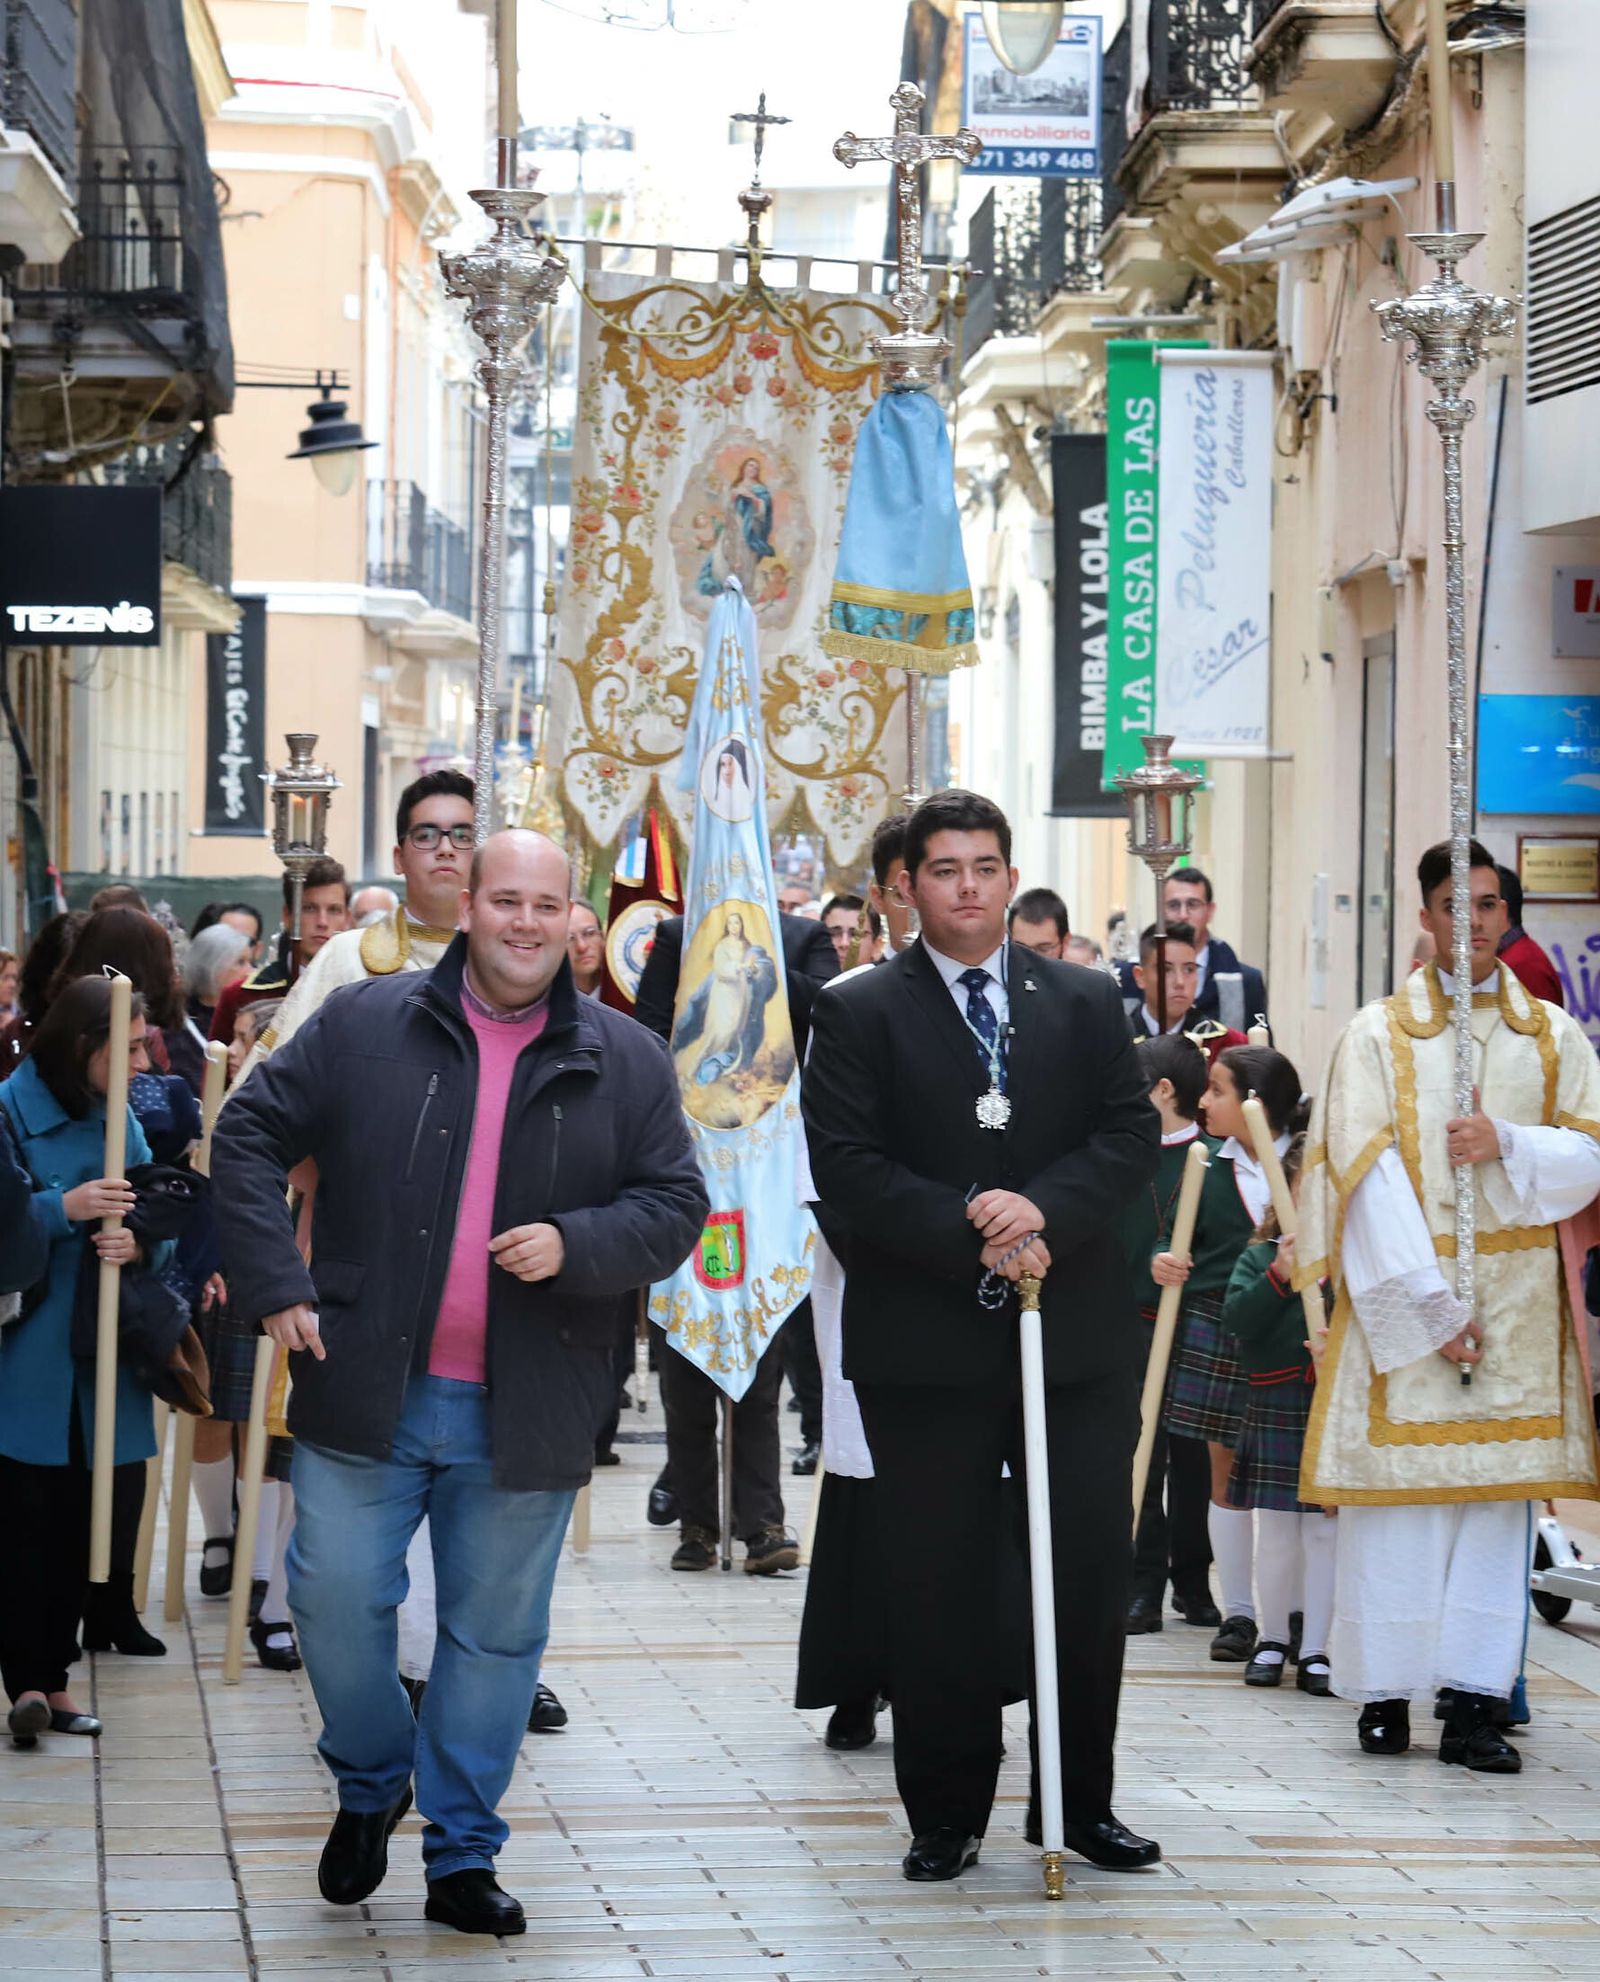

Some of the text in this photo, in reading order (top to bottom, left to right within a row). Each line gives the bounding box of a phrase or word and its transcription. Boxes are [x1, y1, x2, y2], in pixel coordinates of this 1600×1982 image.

[1012, 151, 1051, 168] 349
[1055, 152, 1095, 169] 468
[1225, 378, 1247, 488] Caballeros
[1079, 502, 1109, 750] BIMBA Y LOLA
[1121, 396, 1156, 734] LA CASA DE LAS
